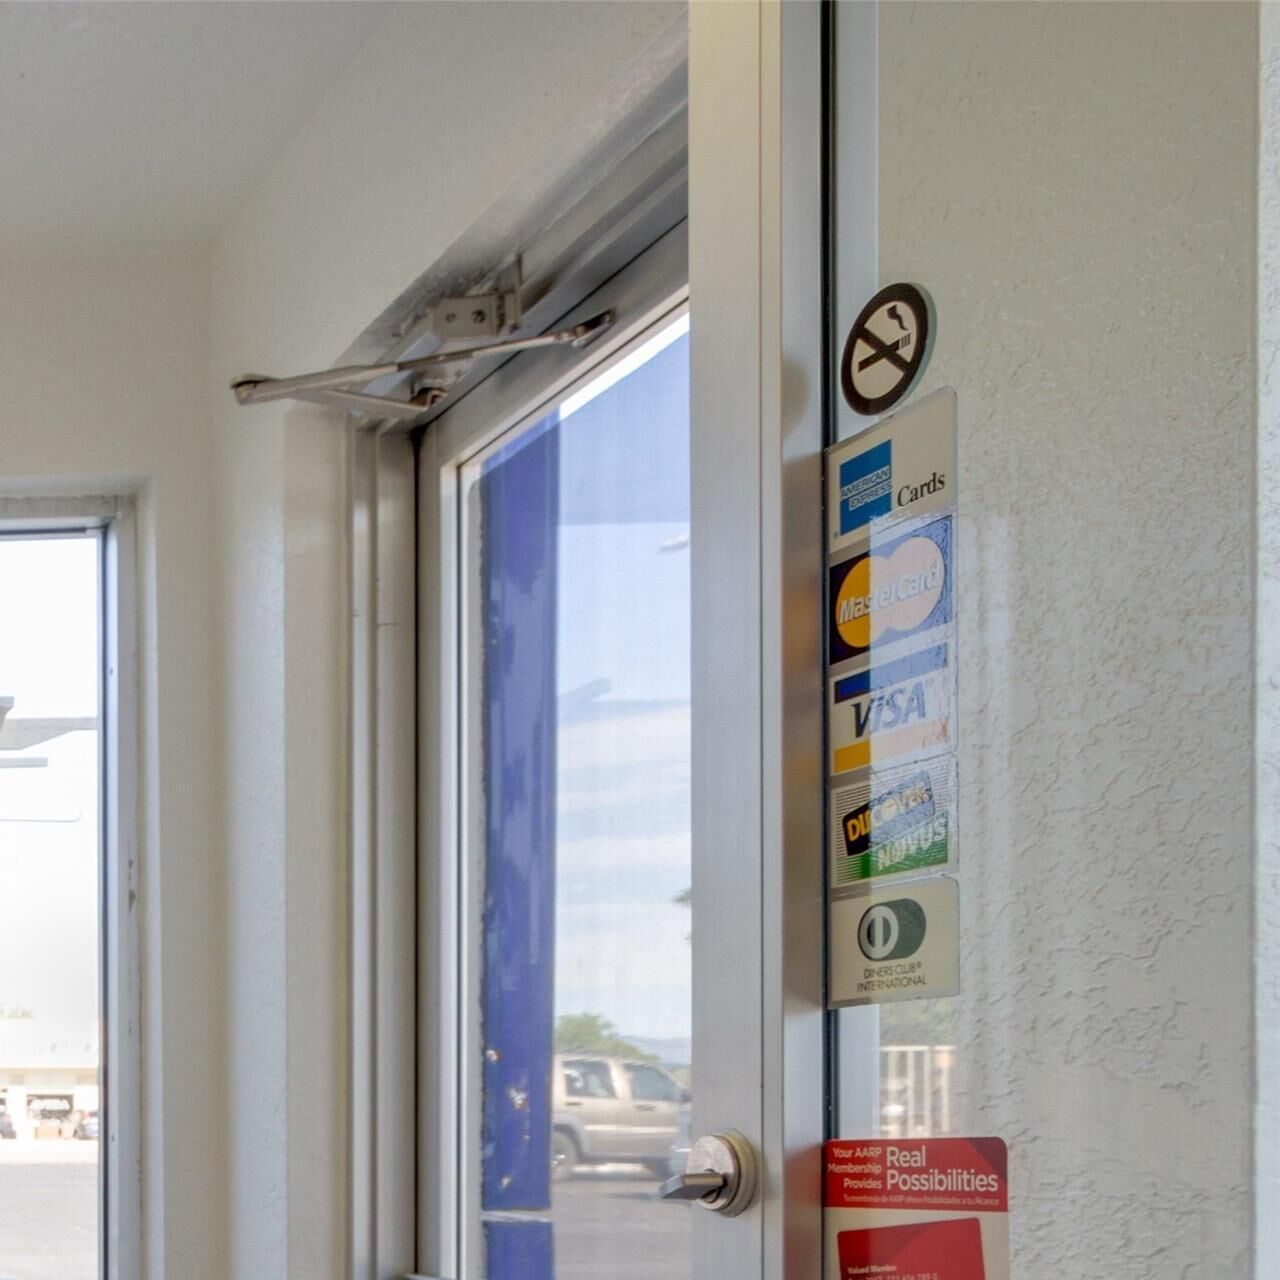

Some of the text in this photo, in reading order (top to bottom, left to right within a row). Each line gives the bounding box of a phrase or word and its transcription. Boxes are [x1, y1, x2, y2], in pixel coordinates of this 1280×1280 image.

[841, 465, 889, 498] AMERICAN
[897, 472, 946, 507] Cards
[849, 483, 892, 511] EXPRESS
[837, 564, 938, 625] MasterCard
[851, 681, 927, 738] VISA
[863, 963, 917, 980] DINERS CLUB
[857, 976, 927, 993] INTERNATIONAL
[854, 1147, 882, 1158] AARP
[886, 1146, 926, 1168] Real
[828, 1163, 882, 1175] Membership
[886, 1168, 998, 1192] Possibilities
[844, 1178, 882, 1189] Provides
